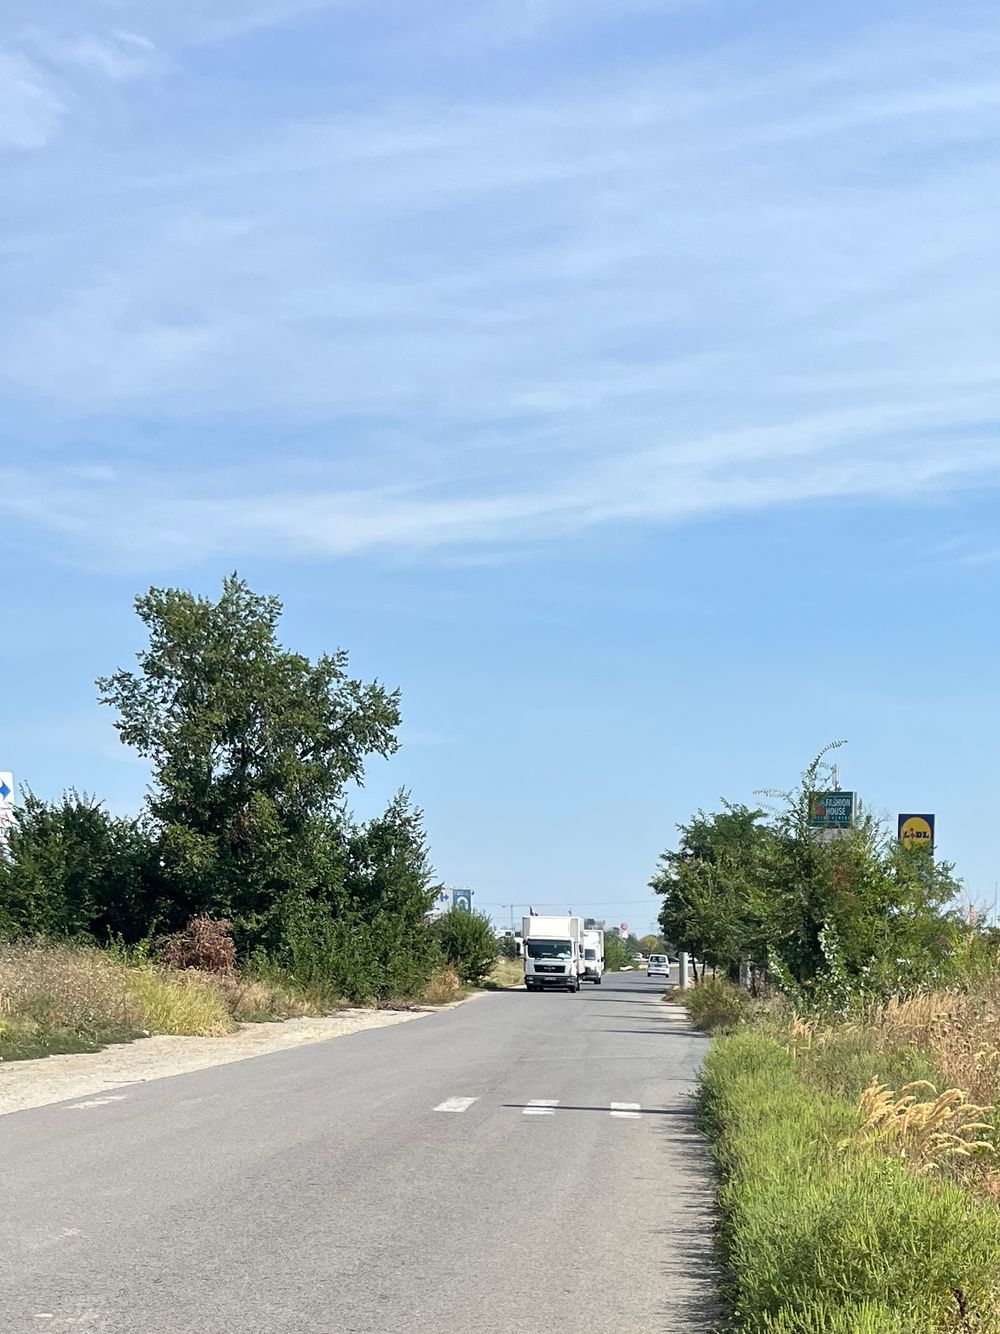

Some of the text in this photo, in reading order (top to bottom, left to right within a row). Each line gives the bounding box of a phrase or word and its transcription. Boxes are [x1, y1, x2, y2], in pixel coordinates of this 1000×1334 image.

[825, 798, 851, 807] FASHION
[825, 807, 846, 816] HOUSE
[903, 828, 930, 839] LIDL
